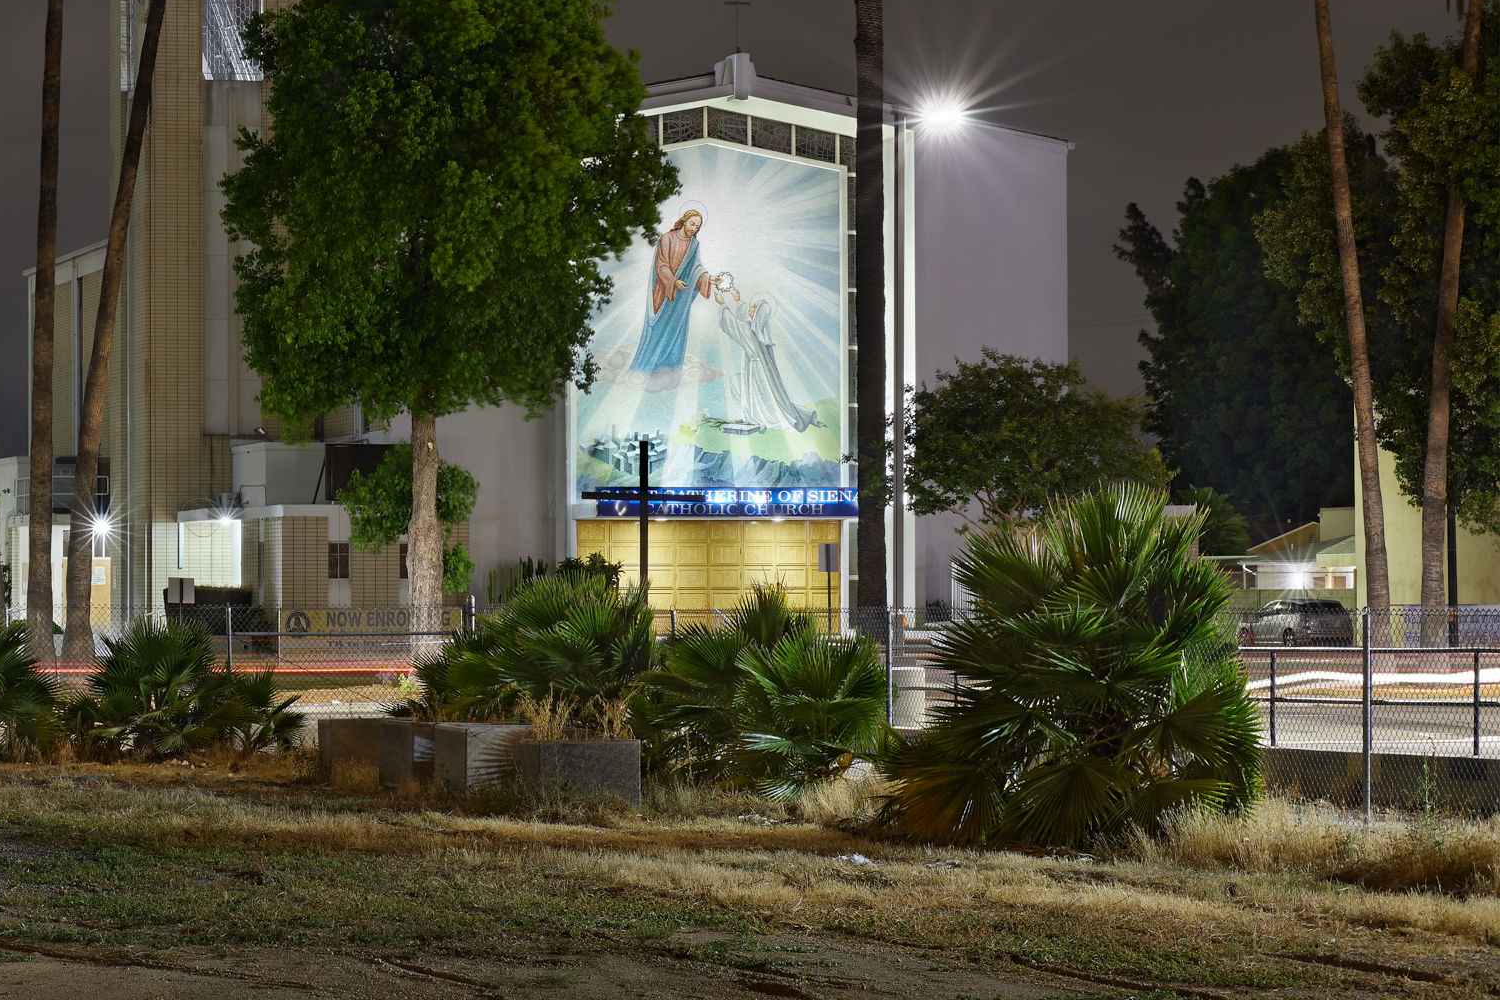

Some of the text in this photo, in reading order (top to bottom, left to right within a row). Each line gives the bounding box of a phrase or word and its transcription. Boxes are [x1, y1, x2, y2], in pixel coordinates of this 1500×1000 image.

[777, 490, 804, 502] OF
[744, 503, 824, 515] CHURCH
[326, 611, 362, 627] NOW
[366, 611, 451, 627] ENROG
